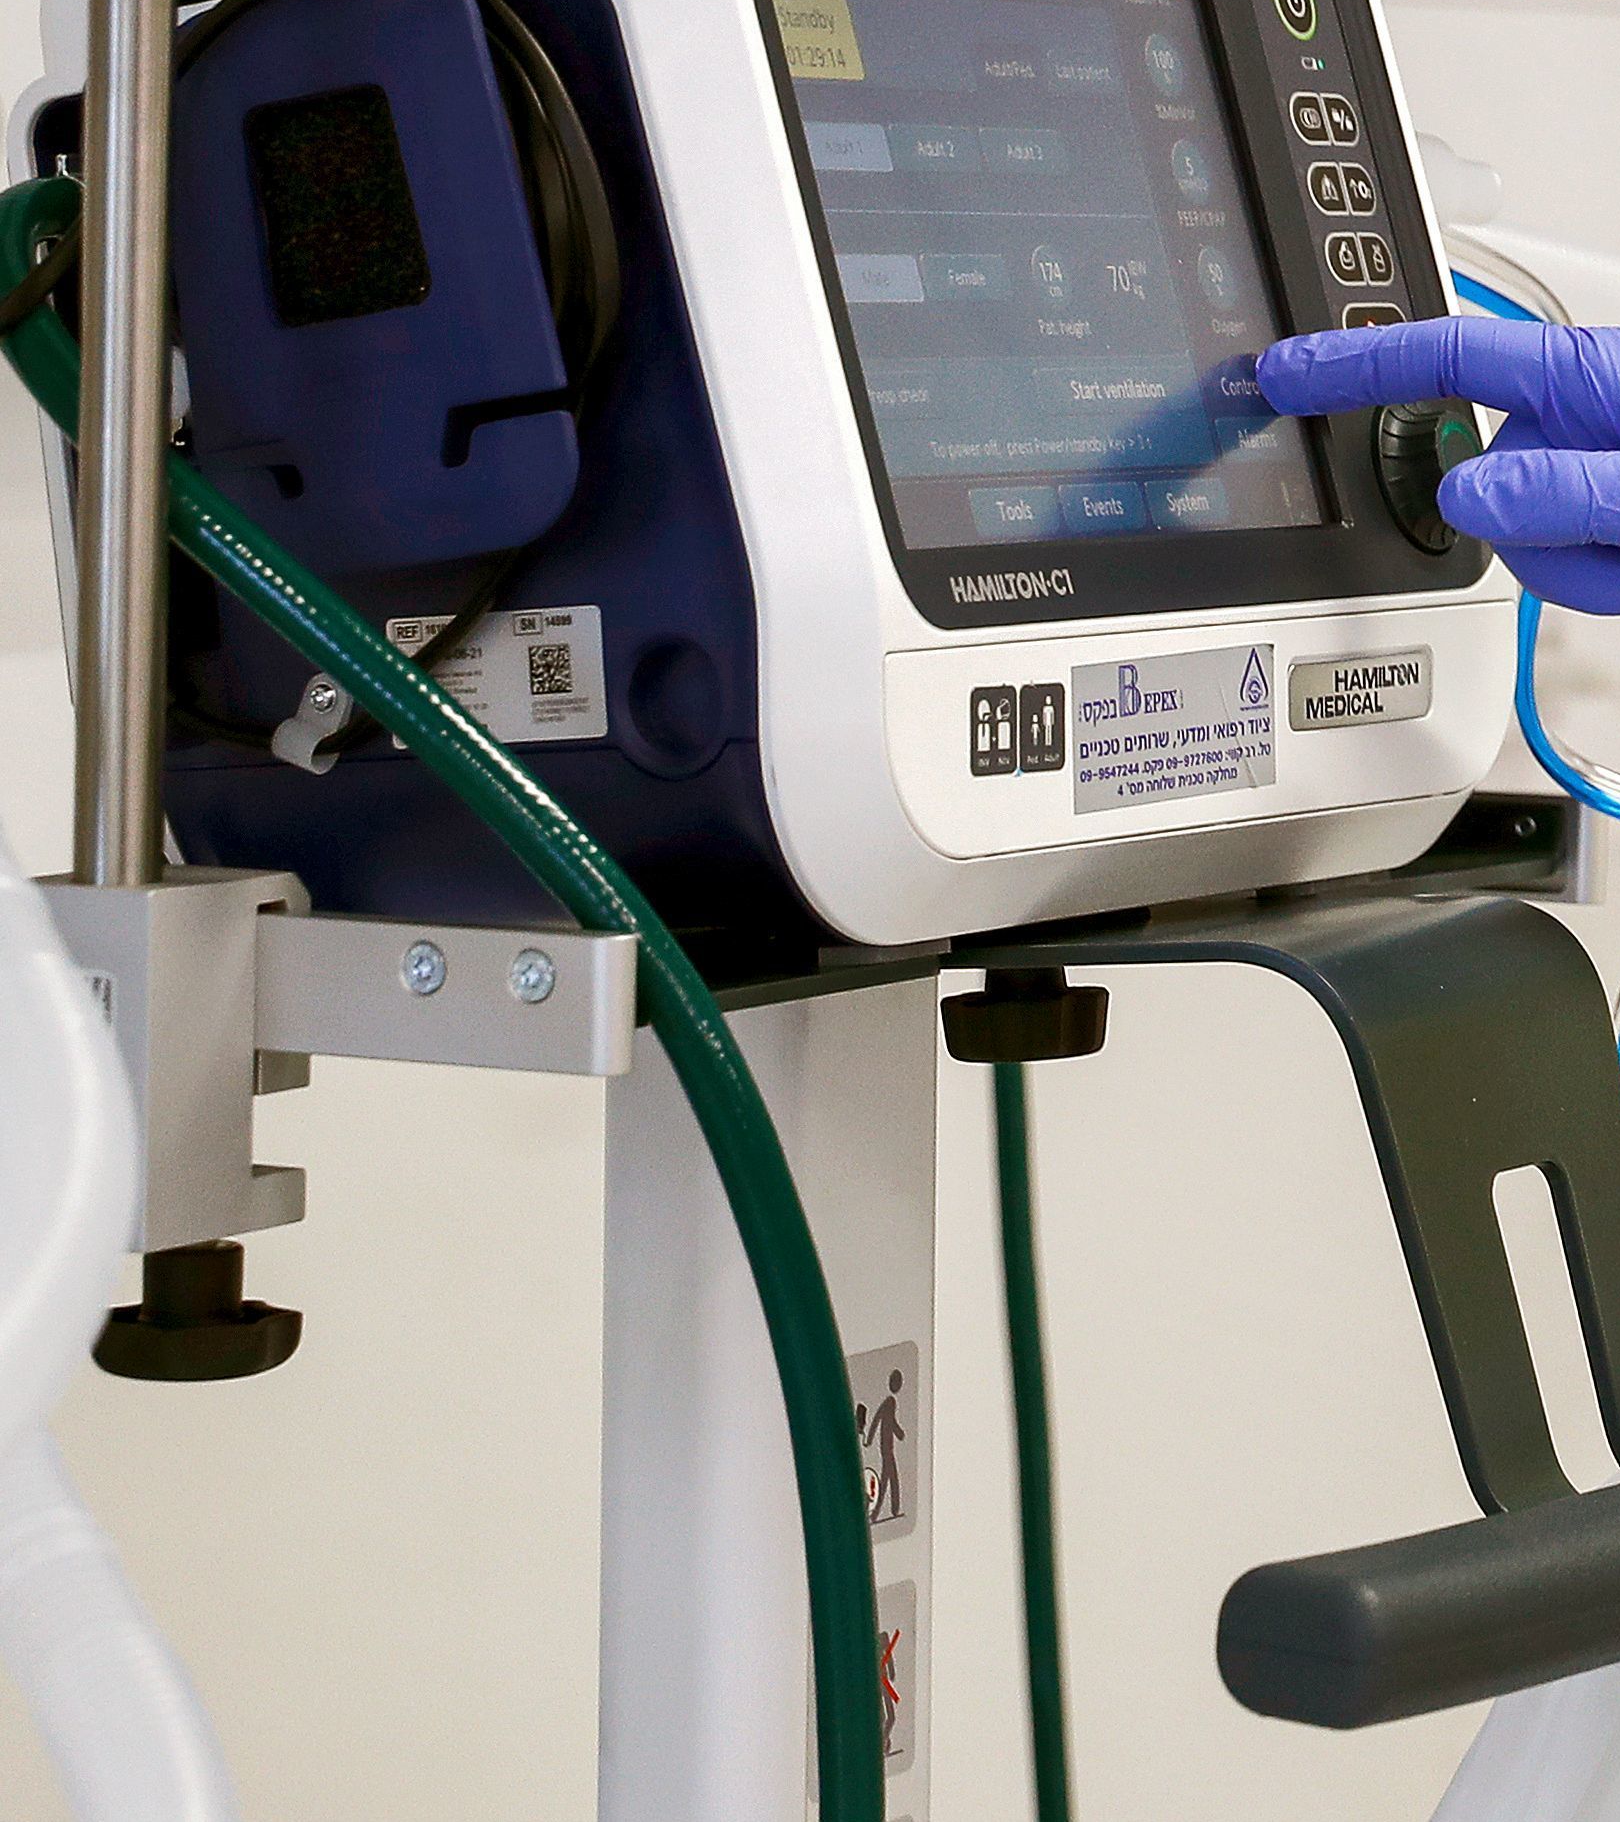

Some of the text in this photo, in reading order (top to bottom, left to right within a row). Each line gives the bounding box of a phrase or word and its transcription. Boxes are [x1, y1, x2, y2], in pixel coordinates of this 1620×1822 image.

[778, 6, 836, 35] Standby
[1153, 50, 1175, 70] 100
[949, 269, 987, 287] Female
[1038, 261, 1063, 282] 174
[1106, 265, 1131, 293] 70
[1070, 378, 1167, 401] Start ventilation
[1220, 377, 1260, 397] Contro
[1238, 429, 1279, 449] Alarms
[996, 499, 1033, 521] Tools
[1083, 496, 1124, 518] Events
[1166, 492, 1210, 517] System
[397, 625, 418, 639] REF
[520, 617, 536, 631] SN
[1334, 662, 1419, 692] HAMILTON
[1306, 691, 1384, 720] MEDICAL
[1213, 720, 1245, 740] רפואי
[1247, 716, 1271, 734] ציוד
[1079, 737, 1120, 760] טכניים
[1124, 732, 1170, 754] שרותים
[1205, 765, 1238, 787] מחלקה
[1117, 784, 1125, 797] 4
